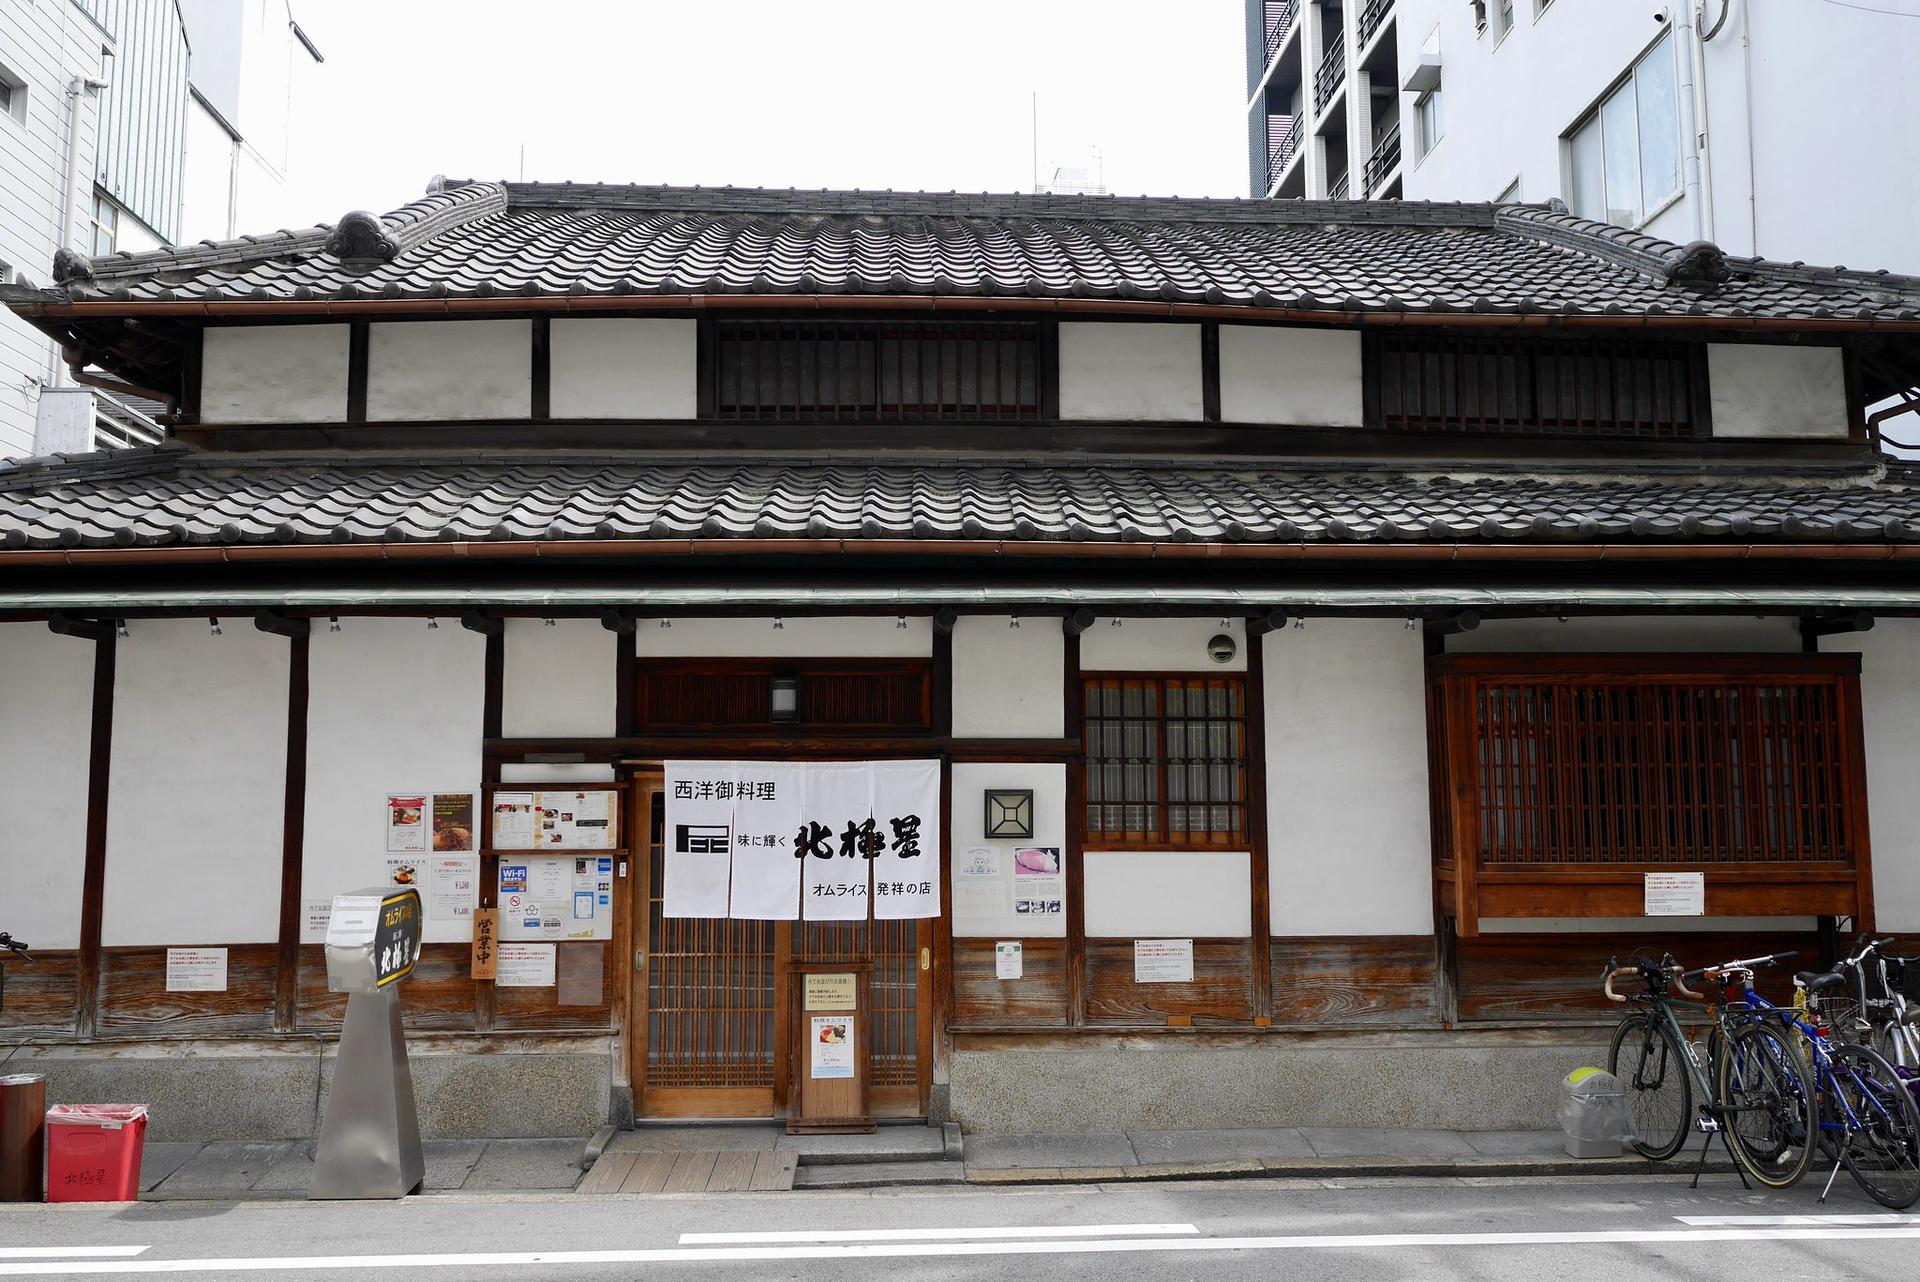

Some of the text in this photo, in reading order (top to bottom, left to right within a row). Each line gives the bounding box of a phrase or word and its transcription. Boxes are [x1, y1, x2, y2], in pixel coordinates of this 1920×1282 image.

[674, 780, 776, 800] 西洋御料理
[737, 834, 786, 848] 味に輝く
[793, 814, 922, 860] 北極星
[502, 869, 526, 878] Wi-Fi
[813, 881, 931, 897] オムライス 発祥の店
[477, 918, 493, 965] 営業中
